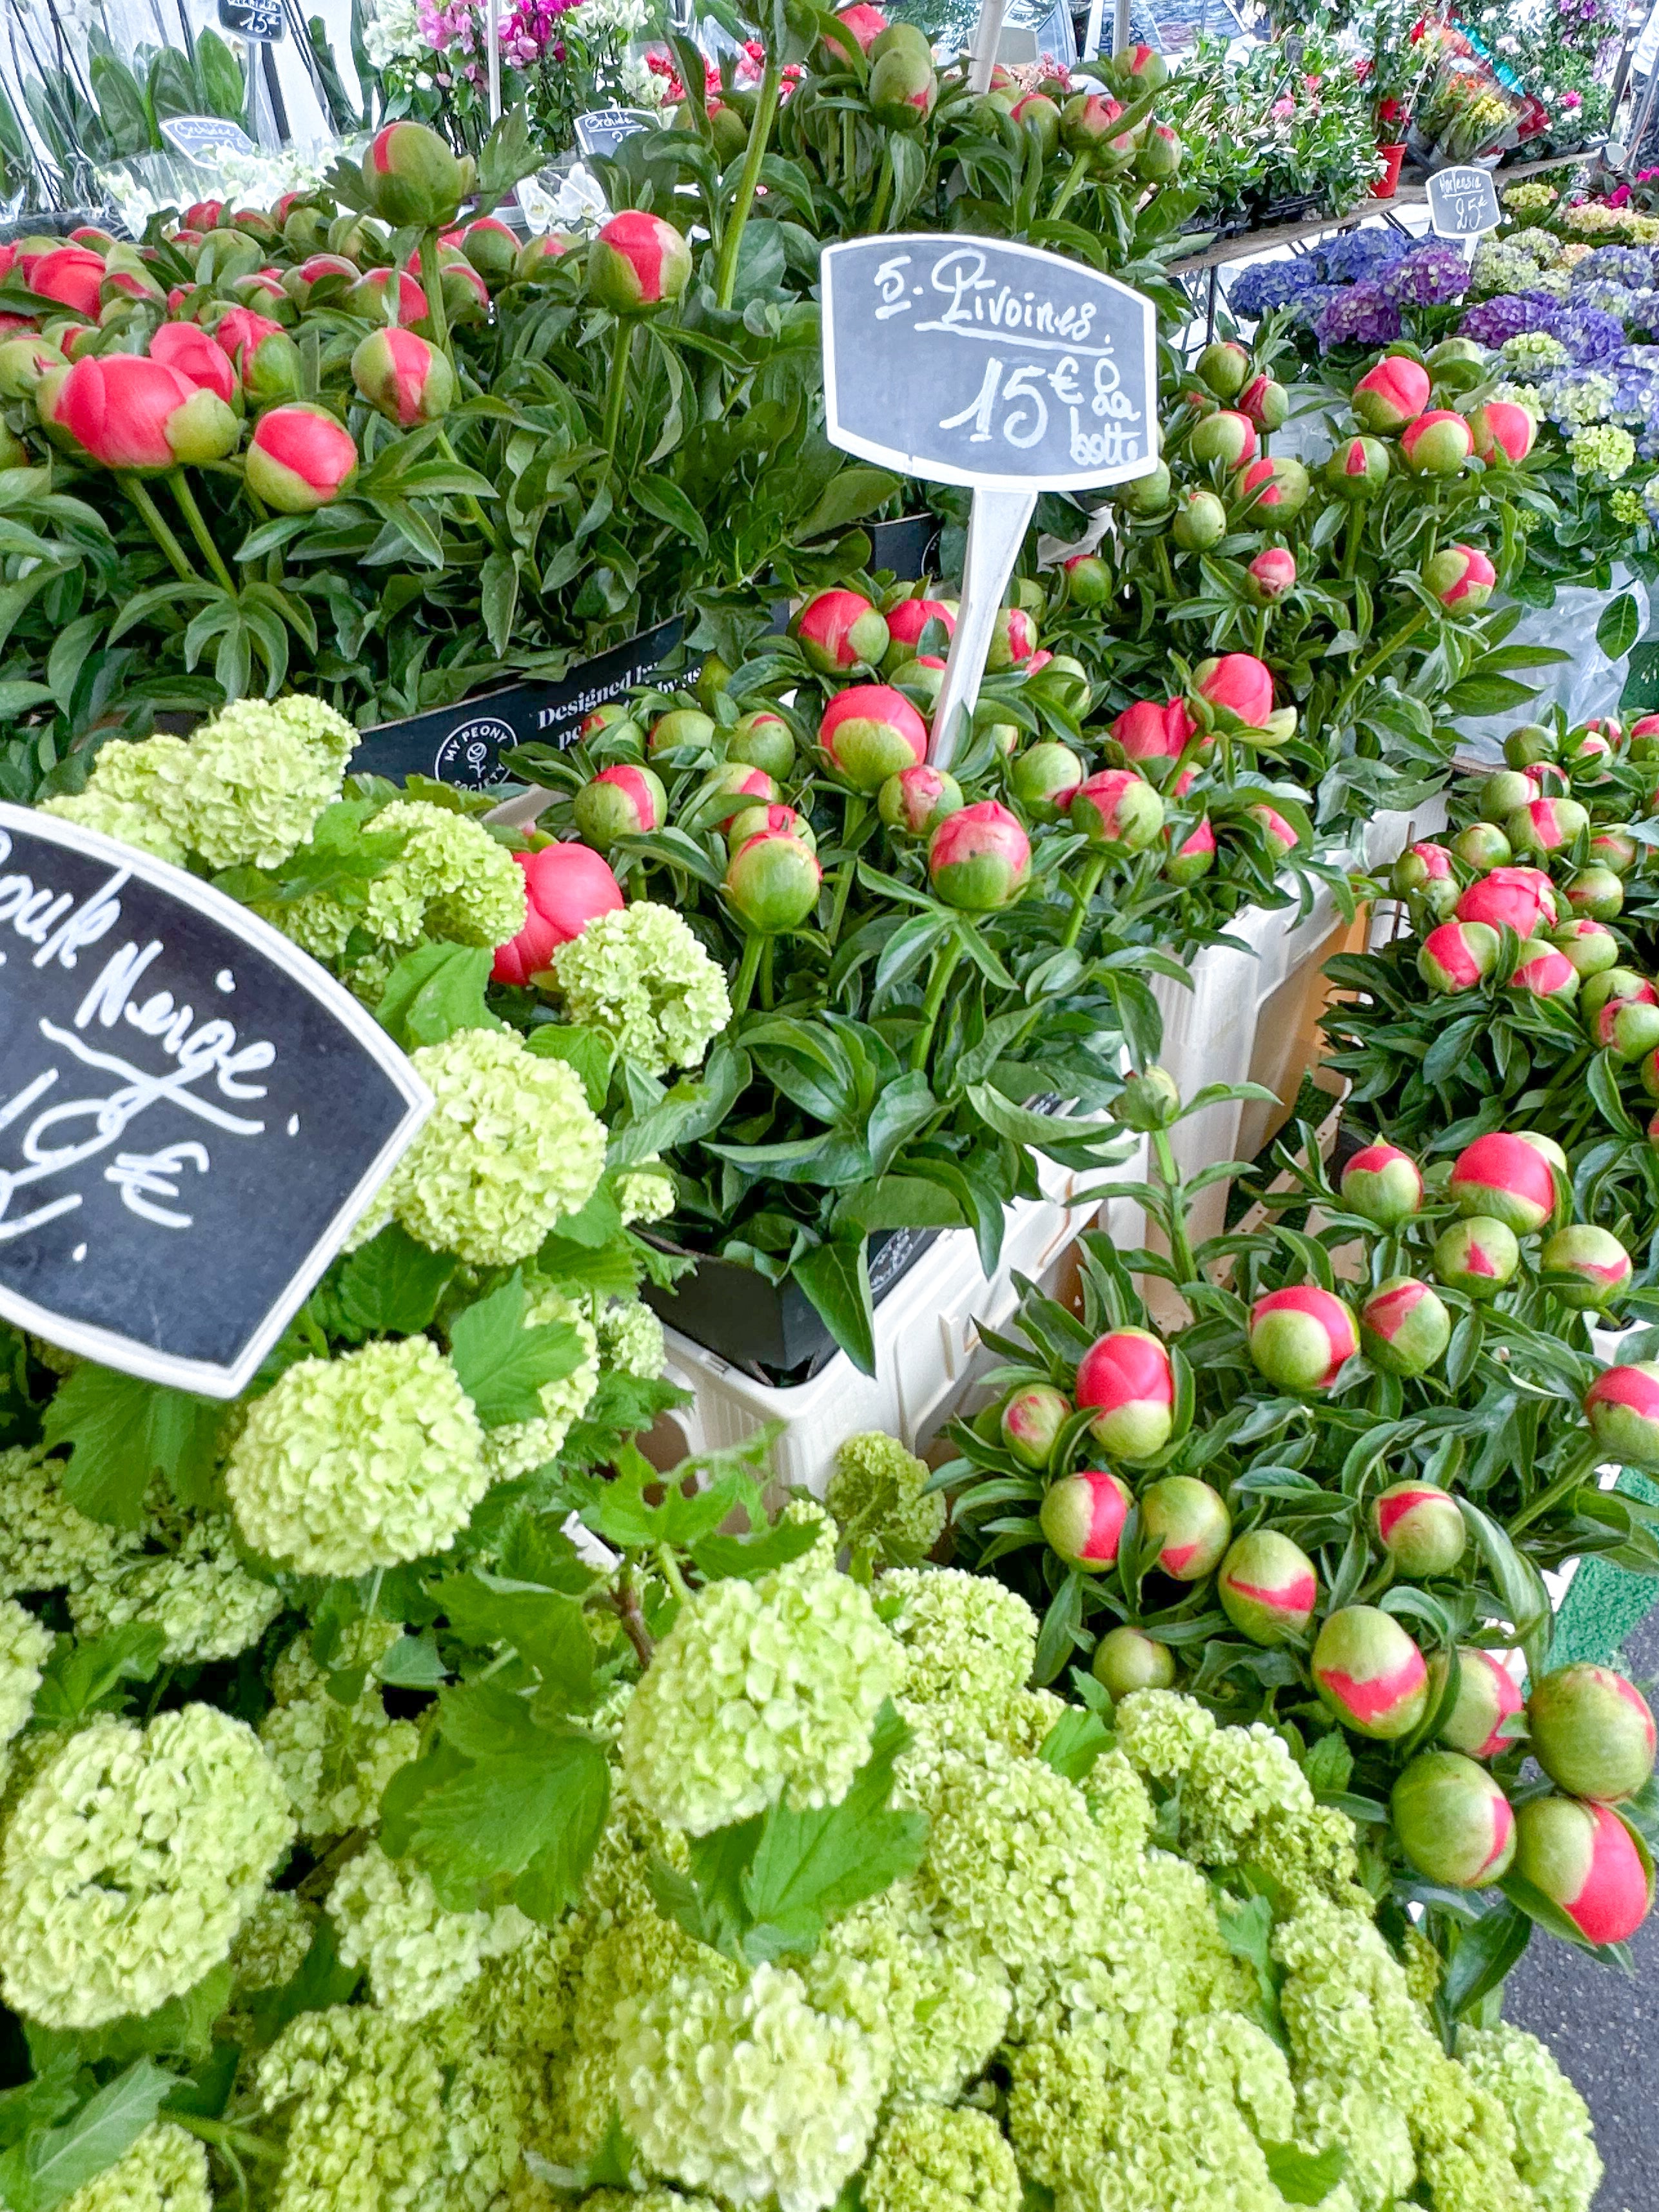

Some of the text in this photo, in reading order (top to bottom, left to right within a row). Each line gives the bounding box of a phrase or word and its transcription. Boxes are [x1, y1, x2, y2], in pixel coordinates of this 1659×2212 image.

[538, 669, 632, 730] Designed
[444, 725, 508, 762] MY PEONY
